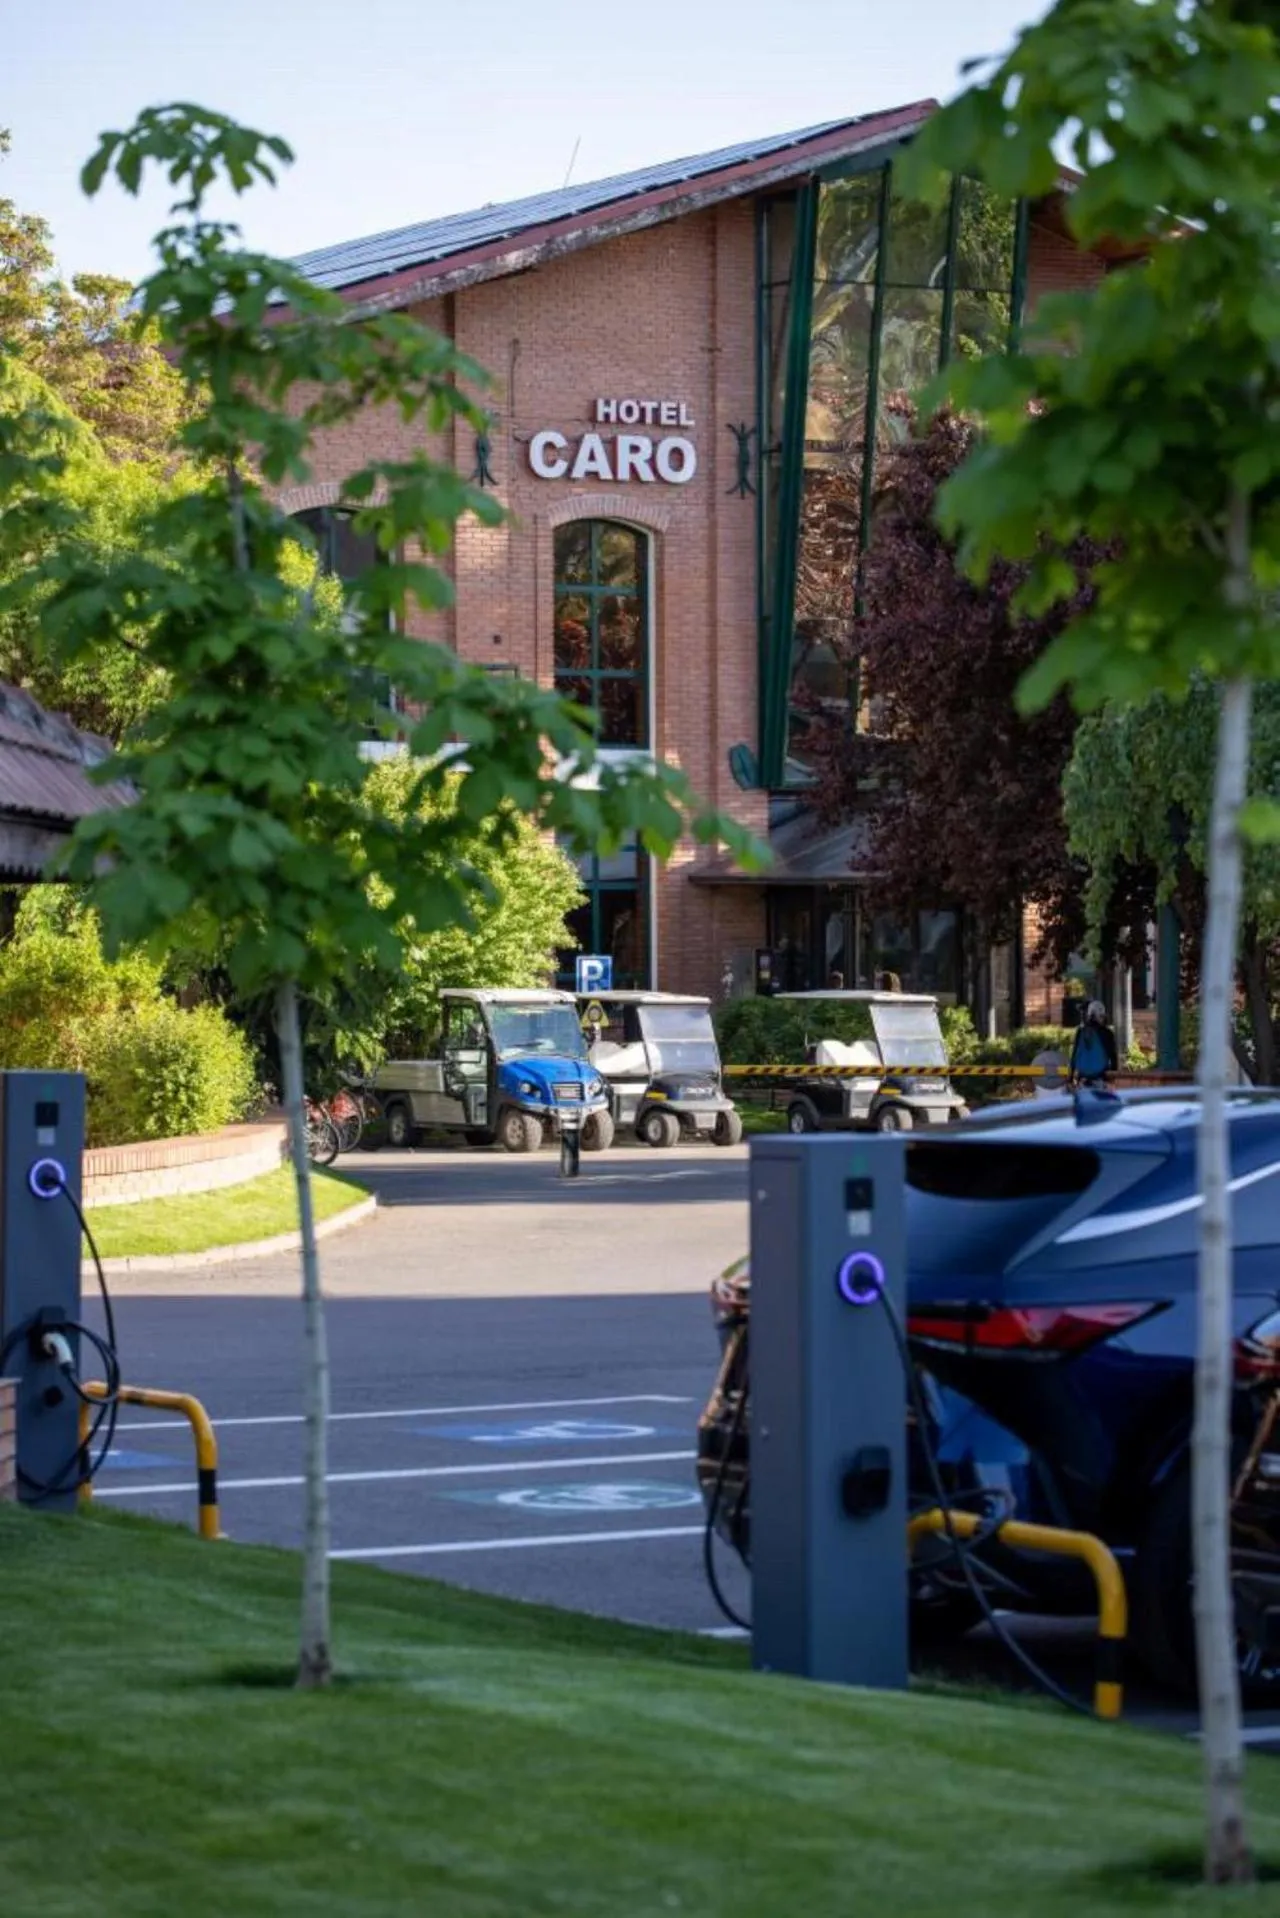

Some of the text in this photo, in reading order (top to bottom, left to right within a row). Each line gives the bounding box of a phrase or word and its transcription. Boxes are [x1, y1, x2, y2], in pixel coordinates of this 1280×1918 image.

[596, 398, 695, 426] HOTEL
[529, 431, 697, 484] CARO
[581, 959, 604, 992] P
